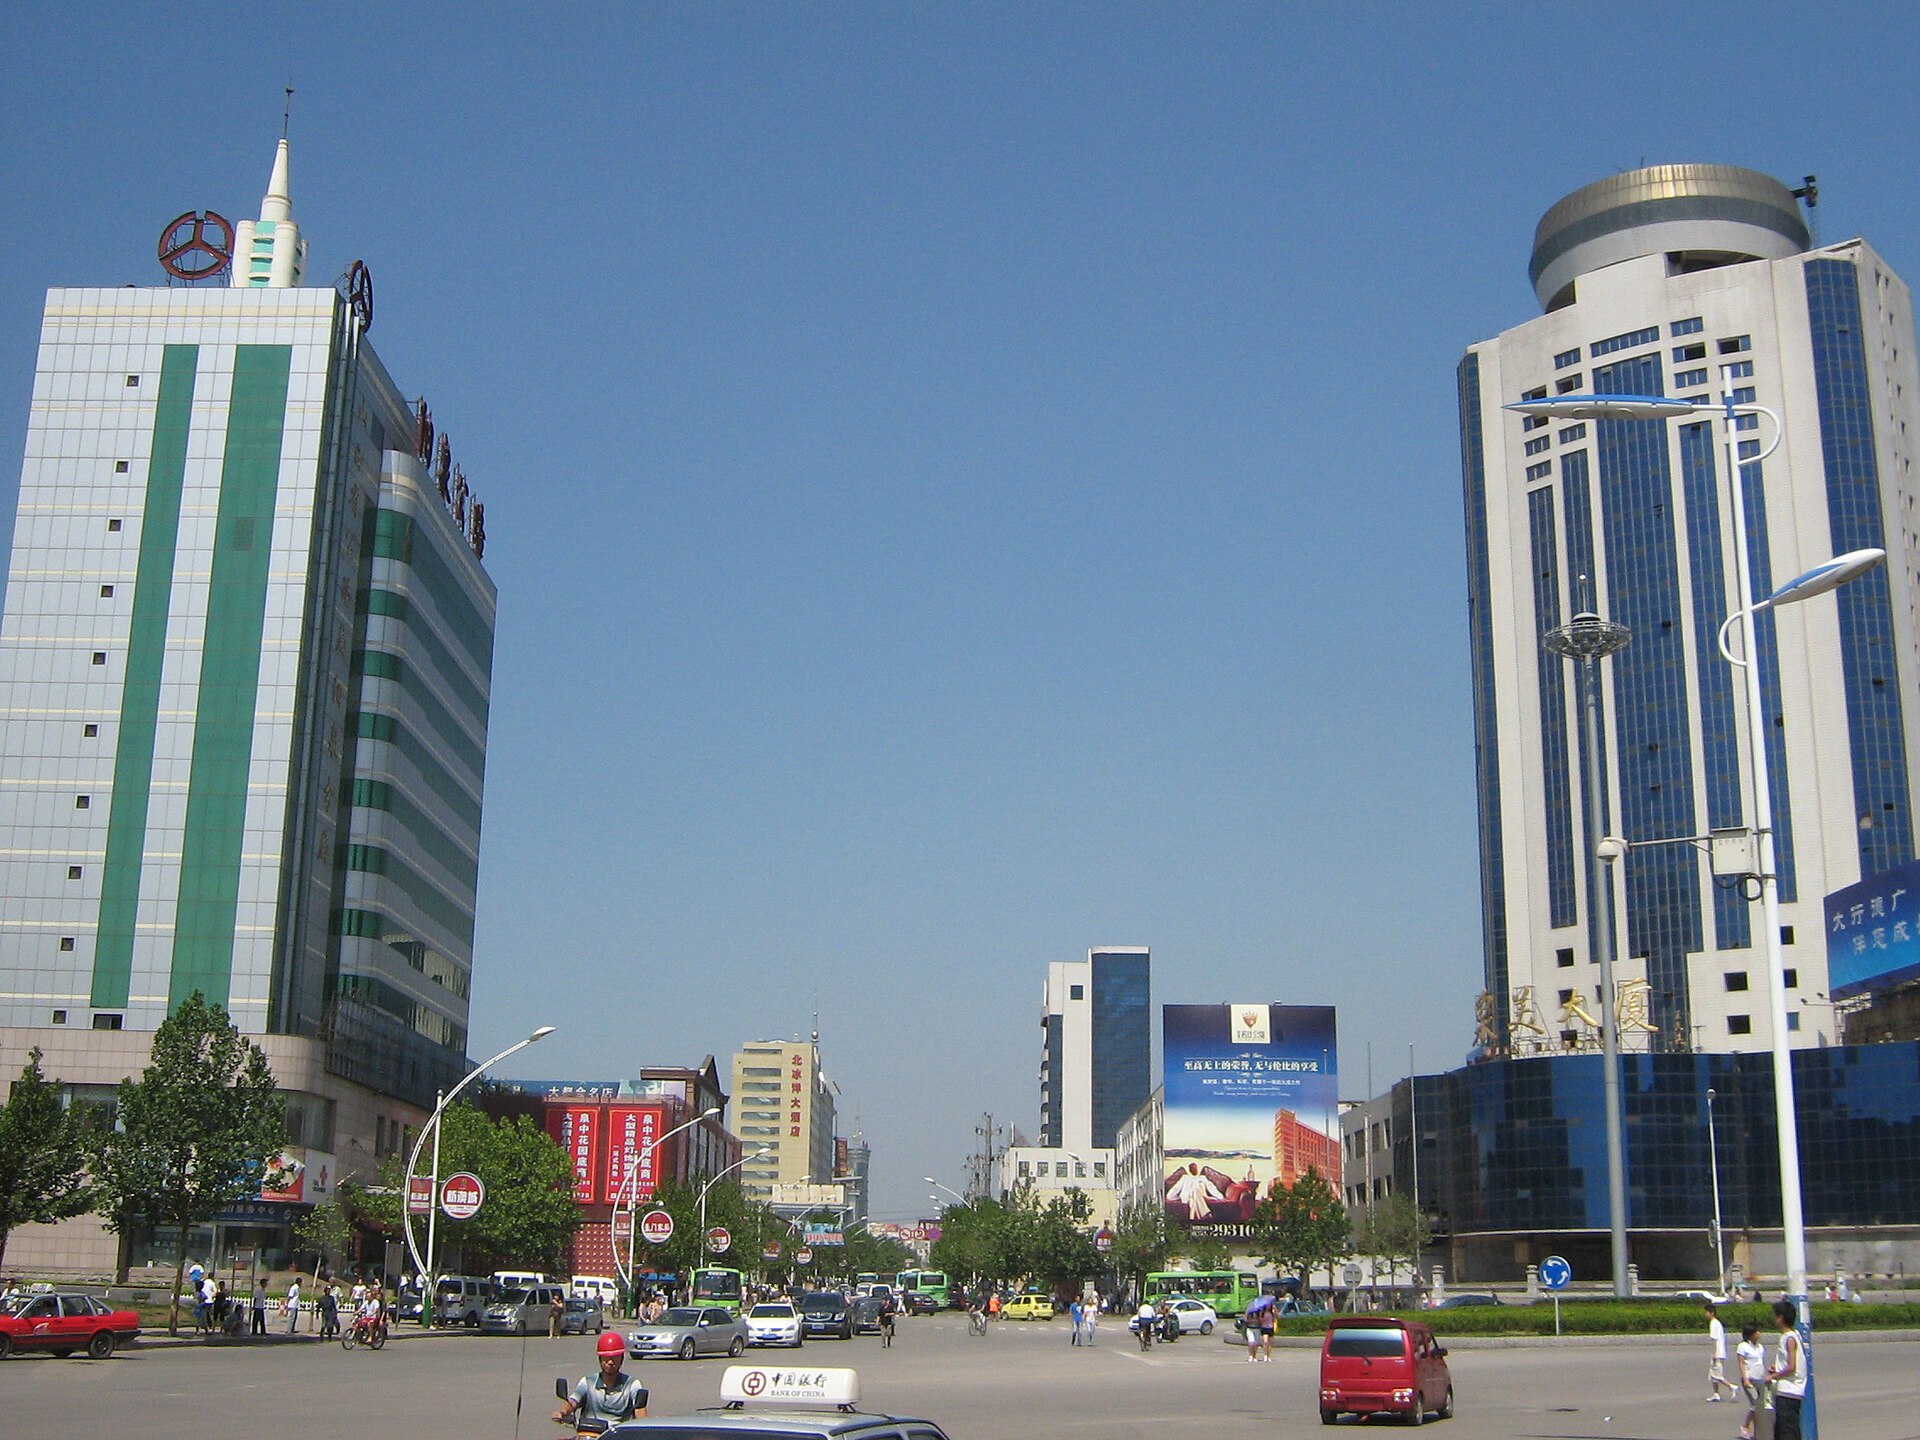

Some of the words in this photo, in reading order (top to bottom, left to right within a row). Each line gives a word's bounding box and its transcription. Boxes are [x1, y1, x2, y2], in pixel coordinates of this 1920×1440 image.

[790, 1055, 803, 1137] 北冰洋大酒店
[771, 1372, 828, 1389] 中国银行
[770, 1389, 790, 1397] BANK
[802, 1390, 826, 1398] CHINA
